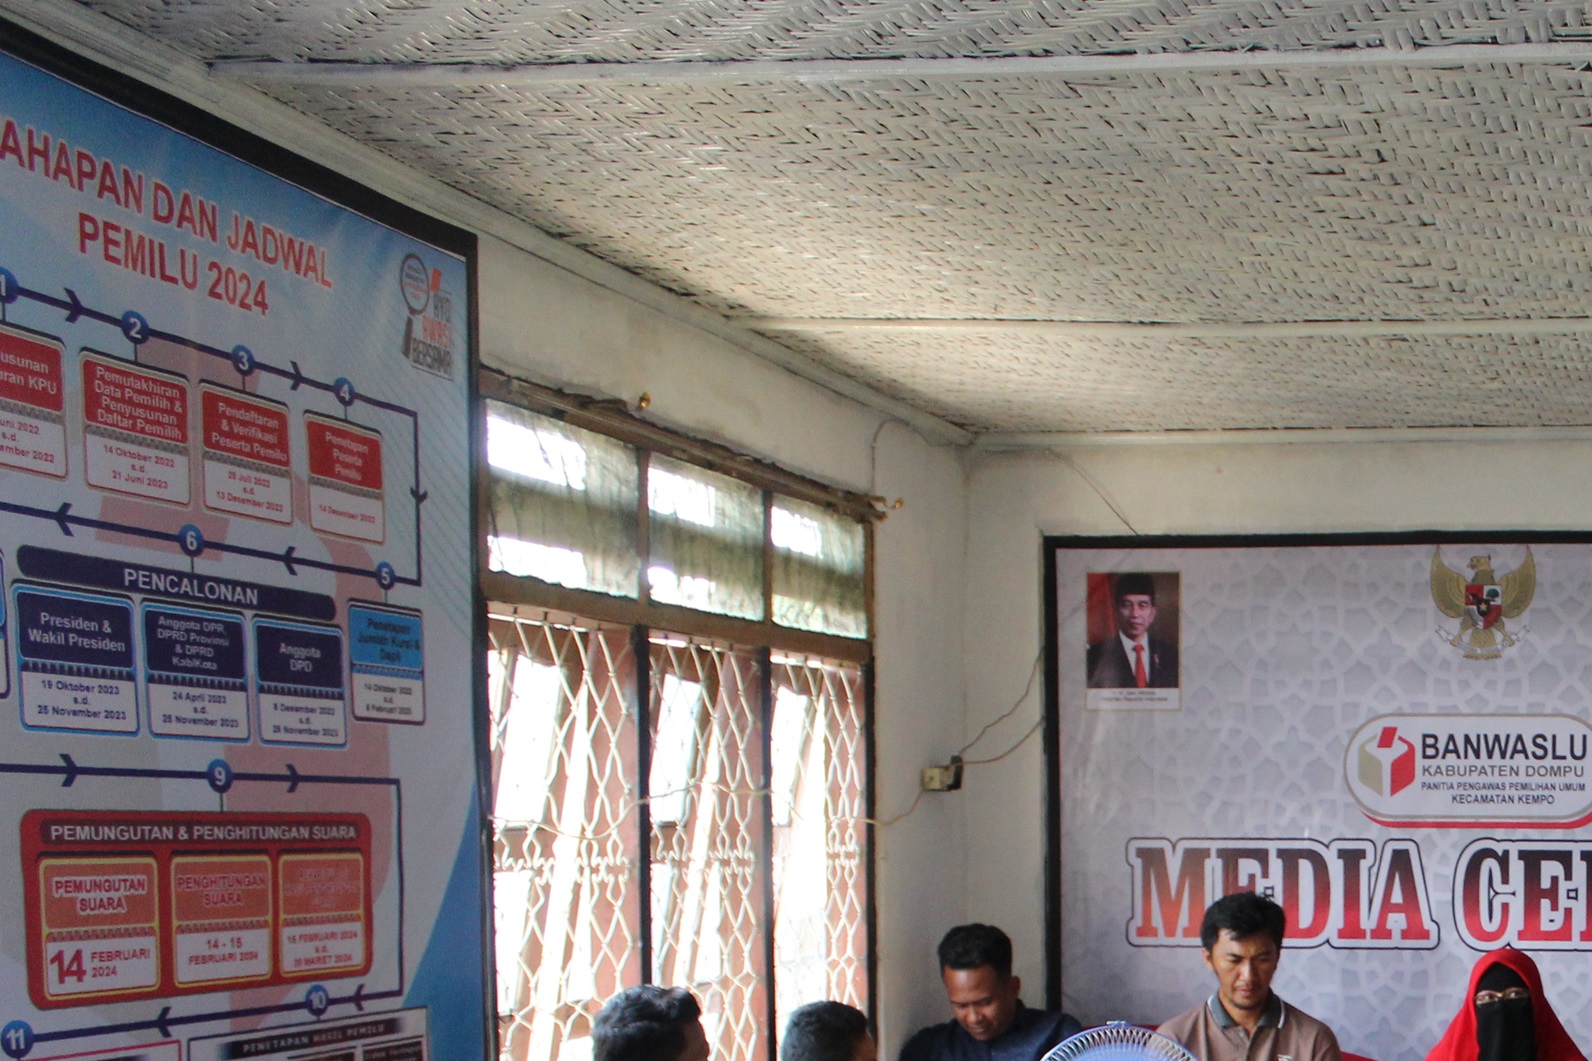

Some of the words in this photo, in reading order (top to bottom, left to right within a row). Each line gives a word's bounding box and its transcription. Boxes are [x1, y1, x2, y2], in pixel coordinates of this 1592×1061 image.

[151, 180, 218, 244] DAN
[227, 210, 334, 288] JADWAL
[78, 211, 199, 291] PEMILU
[207, 261, 270, 317] 2024
[129, 317, 142, 340] 2
[237, 350, 250, 372] 3
[28, 375, 58, 395] KPU
[95, 366, 181, 399] Pemutakhiran
[339, 383, 351, 402] 4
[95, 380, 123, 399] Data
[125, 387, 172, 411] Pemilih
[173, 401, 183, 413] &
[101, 397, 178, 426] Penyusunan
[217, 402, 280, 430] Pendaftaran
[97, 408, 134, 430] Daftar
[136, 418, 182, 441] Pemilih
[103, 444, 114, 454] 14
[116, 446, 152, 463] Oktober
[111, 469, 123, 480] 21
[124, 471, 145, 485] Juni
[185, 530, 197, 550] 6
[123, 567, 259, 606] PENCALONAN
[380, 567, 391, 586] 5
[39, 612, 99, 633] Presiden
[102, 621, 113, 634] &
[28, 628, 66, 646] Wakil
[68, 633, 126, 653] Presiden
[56, 680, 96, 694] Oktober
[52, 705, 101, 719] November
[1420, 732, 1589, 761] BANWASLU
[214, 766, 226, 786] 9
[1421, 765, 1520, 778] KABUPATEN
[1525, 765, 1585, 778] DOMPU
[1420, 781, 1455, 792] PANITIA
[1456, 781, 1507, 792] PENGAWAS
[1508, 782, 1557, 792] PEMILIHAN
[1558, 782, 1586, 793] UMUM
[1451, 793, 1515, 805] KECAMATAN
[1517, 793, 1556, 805] KEMPO
[50, 825, 174, 842] PEMUNGUTAN
[177, 825, 189, 841] &
[192, 825, 310, 841] PENGHITUNGAN
[311, 825, 357, 840] SUARA
[54, 876, 148, 895] PEMUNGUTAN
[176, 874, 266, 890] PENGHITUNGAN
[78, 897, 127, 913] SUARA
[203, 891, 242, 906] SUARA
[50, 948, 87, 985] 14
[90, 949, 150, 963] FEBRUARI
[188, 953, 237, 966] FEBRUARI
[90, 966, 118, 978] 2024
[308, 992, 326, 1009] 10
[6, 1028, 26, 1051] 11
